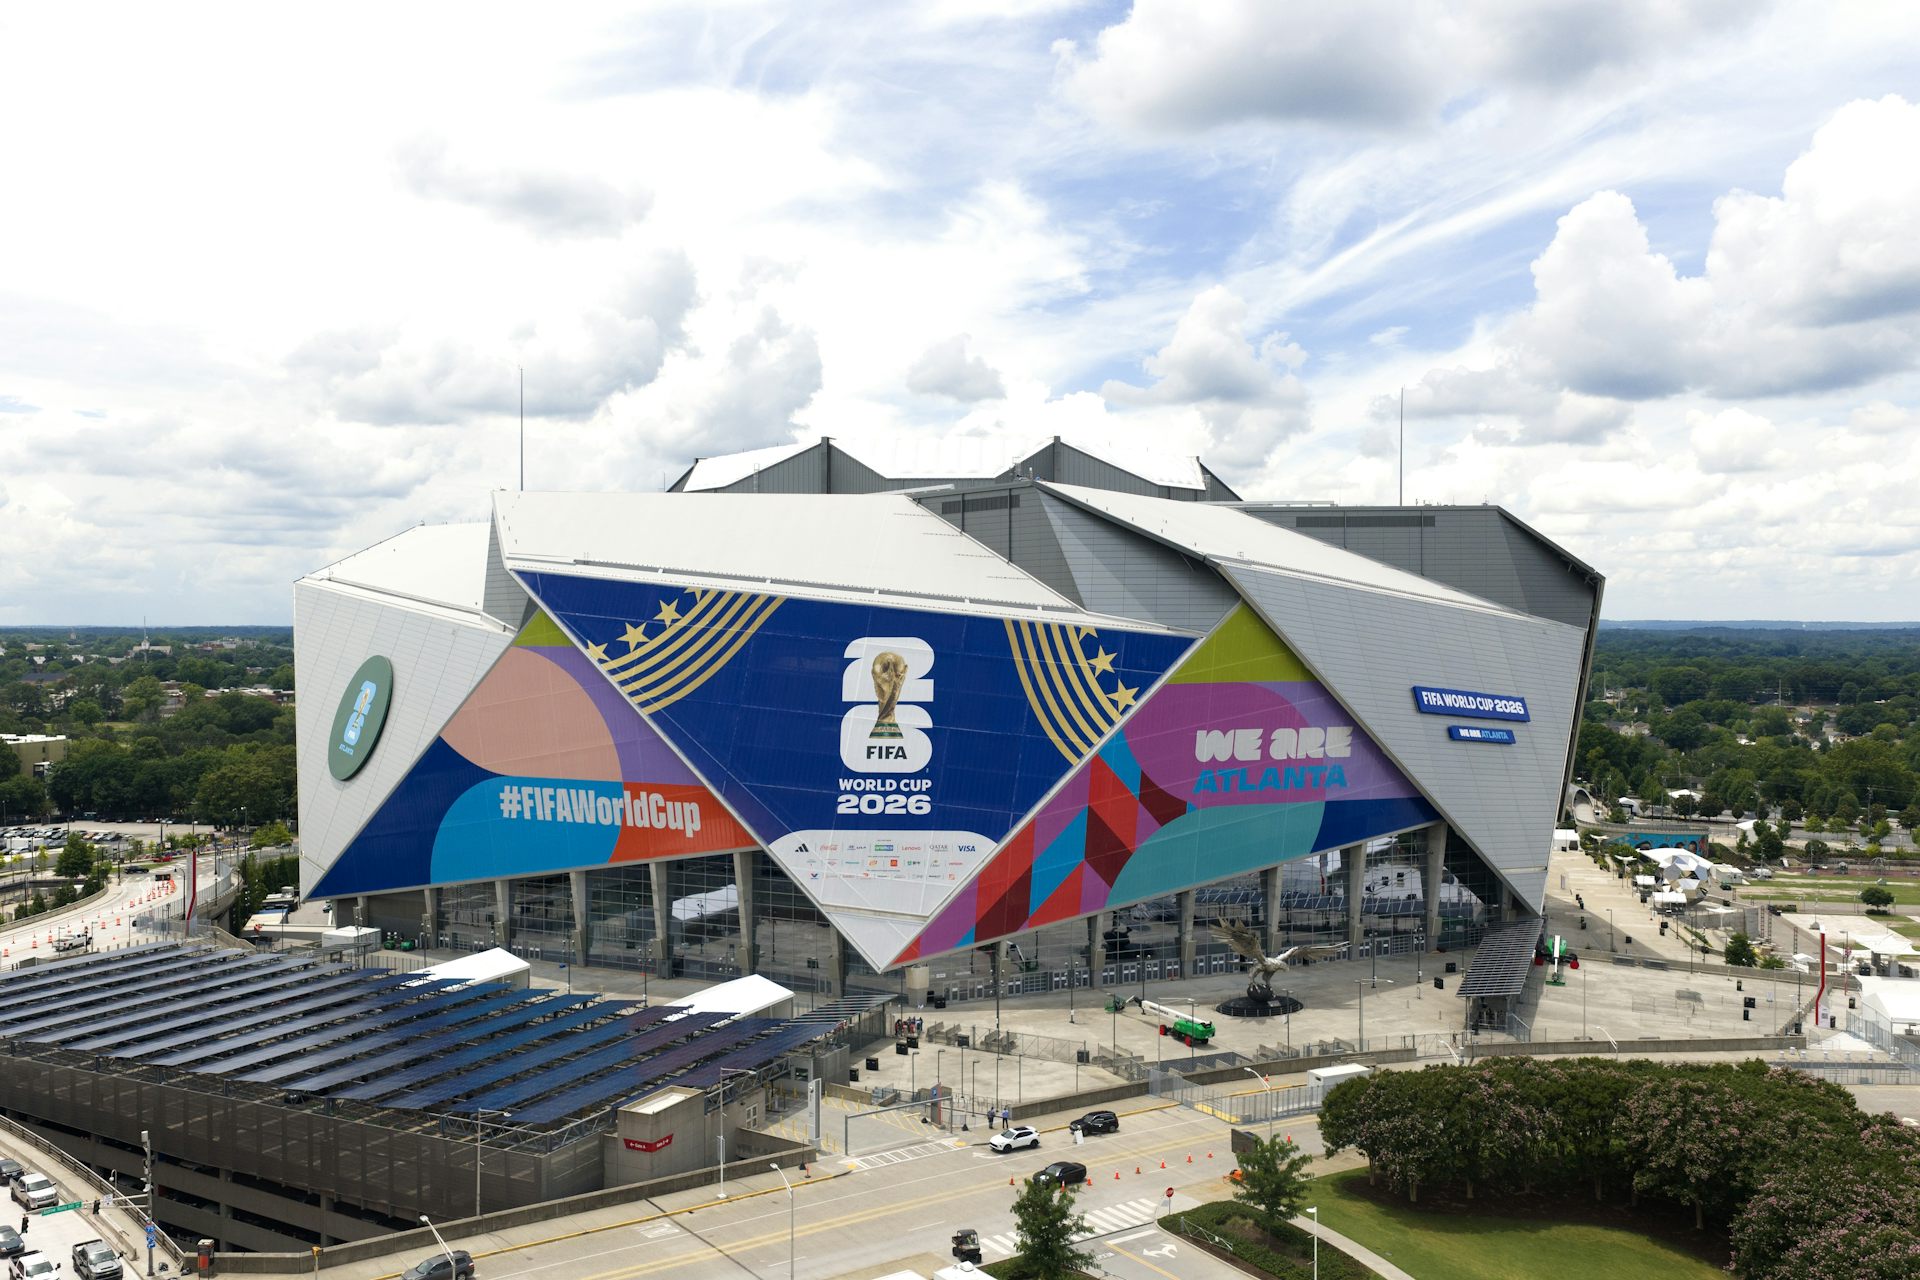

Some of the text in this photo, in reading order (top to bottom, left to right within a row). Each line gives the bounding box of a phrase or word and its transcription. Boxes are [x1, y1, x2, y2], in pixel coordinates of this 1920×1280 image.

[1421, 691, 1525, 714] FIFA WORLD CUP 2026
[1195, 726, 1352, 762] WE ARE
[1459, 728, 1470, 737] WE
[1481, 730, 1509, 740] ATLANTA
[866, 745, 907, 760] FIFA
[838, 778, 932, 792] WORLD CUP
[1192, 763, 1349, 794] ATLANTA
[499, 785, 701, 838] #FIFAWorldCup
[837, 794, 931, 814] 2026
